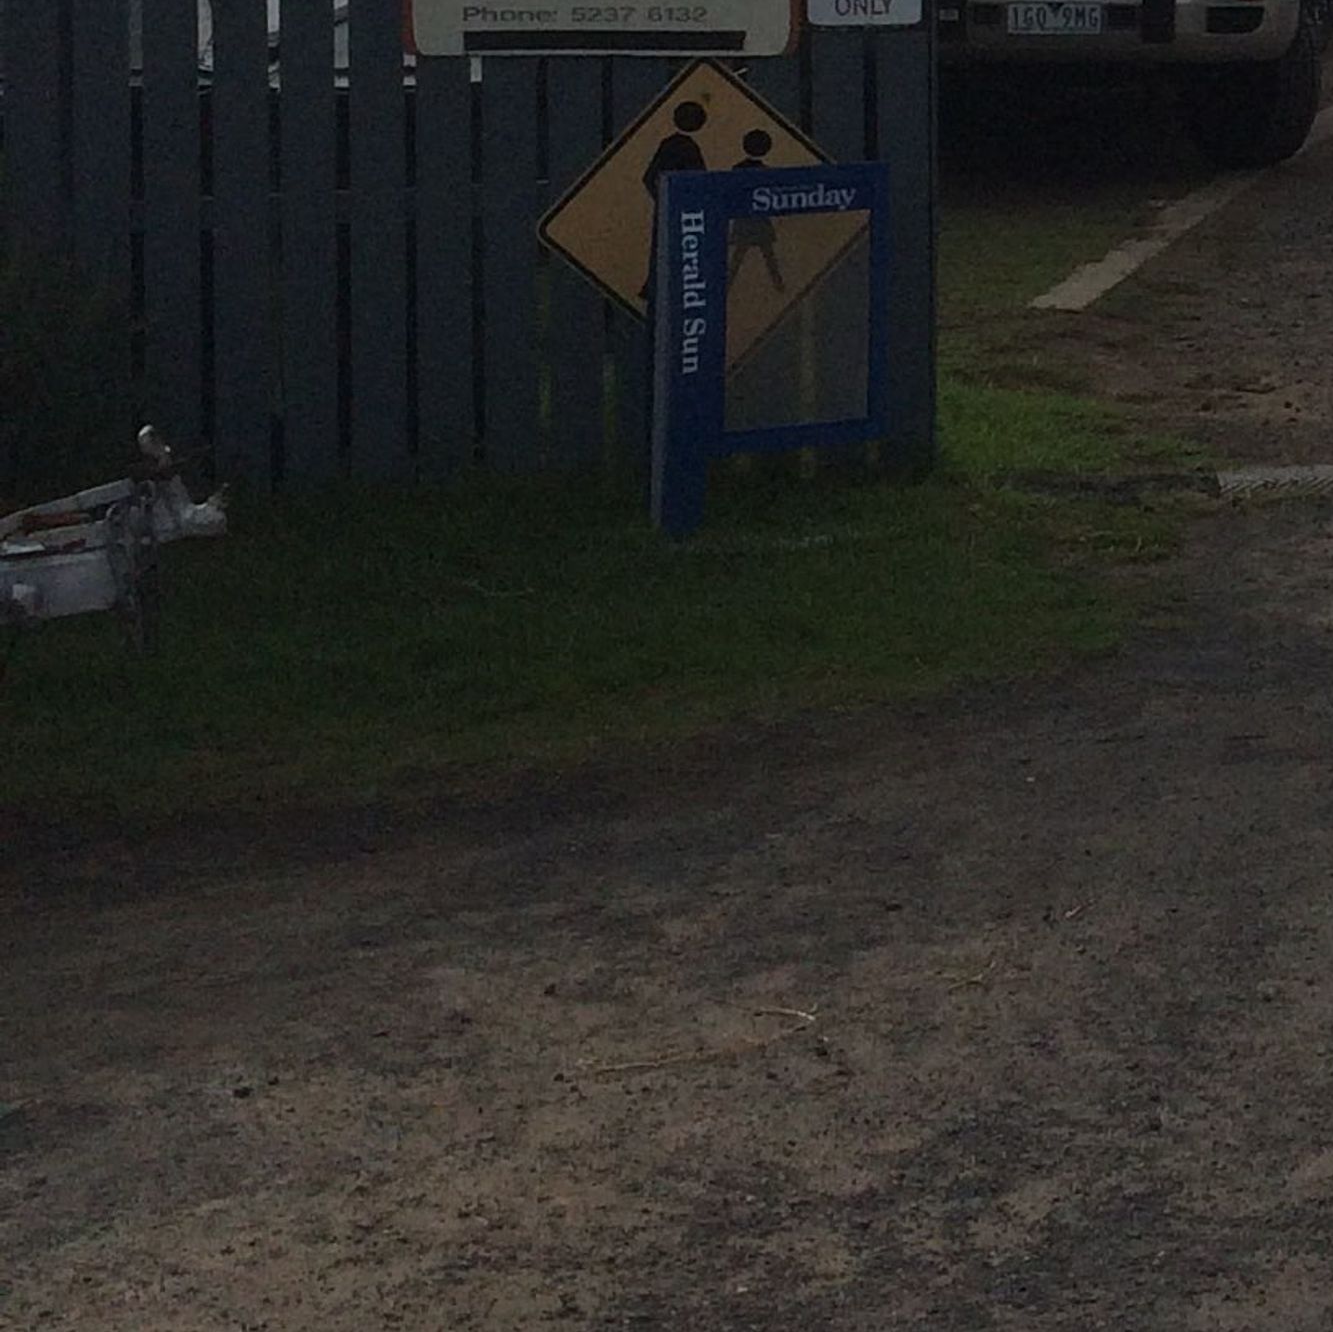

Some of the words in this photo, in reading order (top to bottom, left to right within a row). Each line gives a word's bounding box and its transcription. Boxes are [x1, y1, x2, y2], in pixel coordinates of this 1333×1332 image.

[462, 6, 558, 22] Phone:
[571, 6, 636, 22] 5237
[647, 6, 708, 23] 6132
[751, 183, 857, 212] Sunday
[680, 209, 708, 310] Herald
[681, 317, 708, 376] Sun
